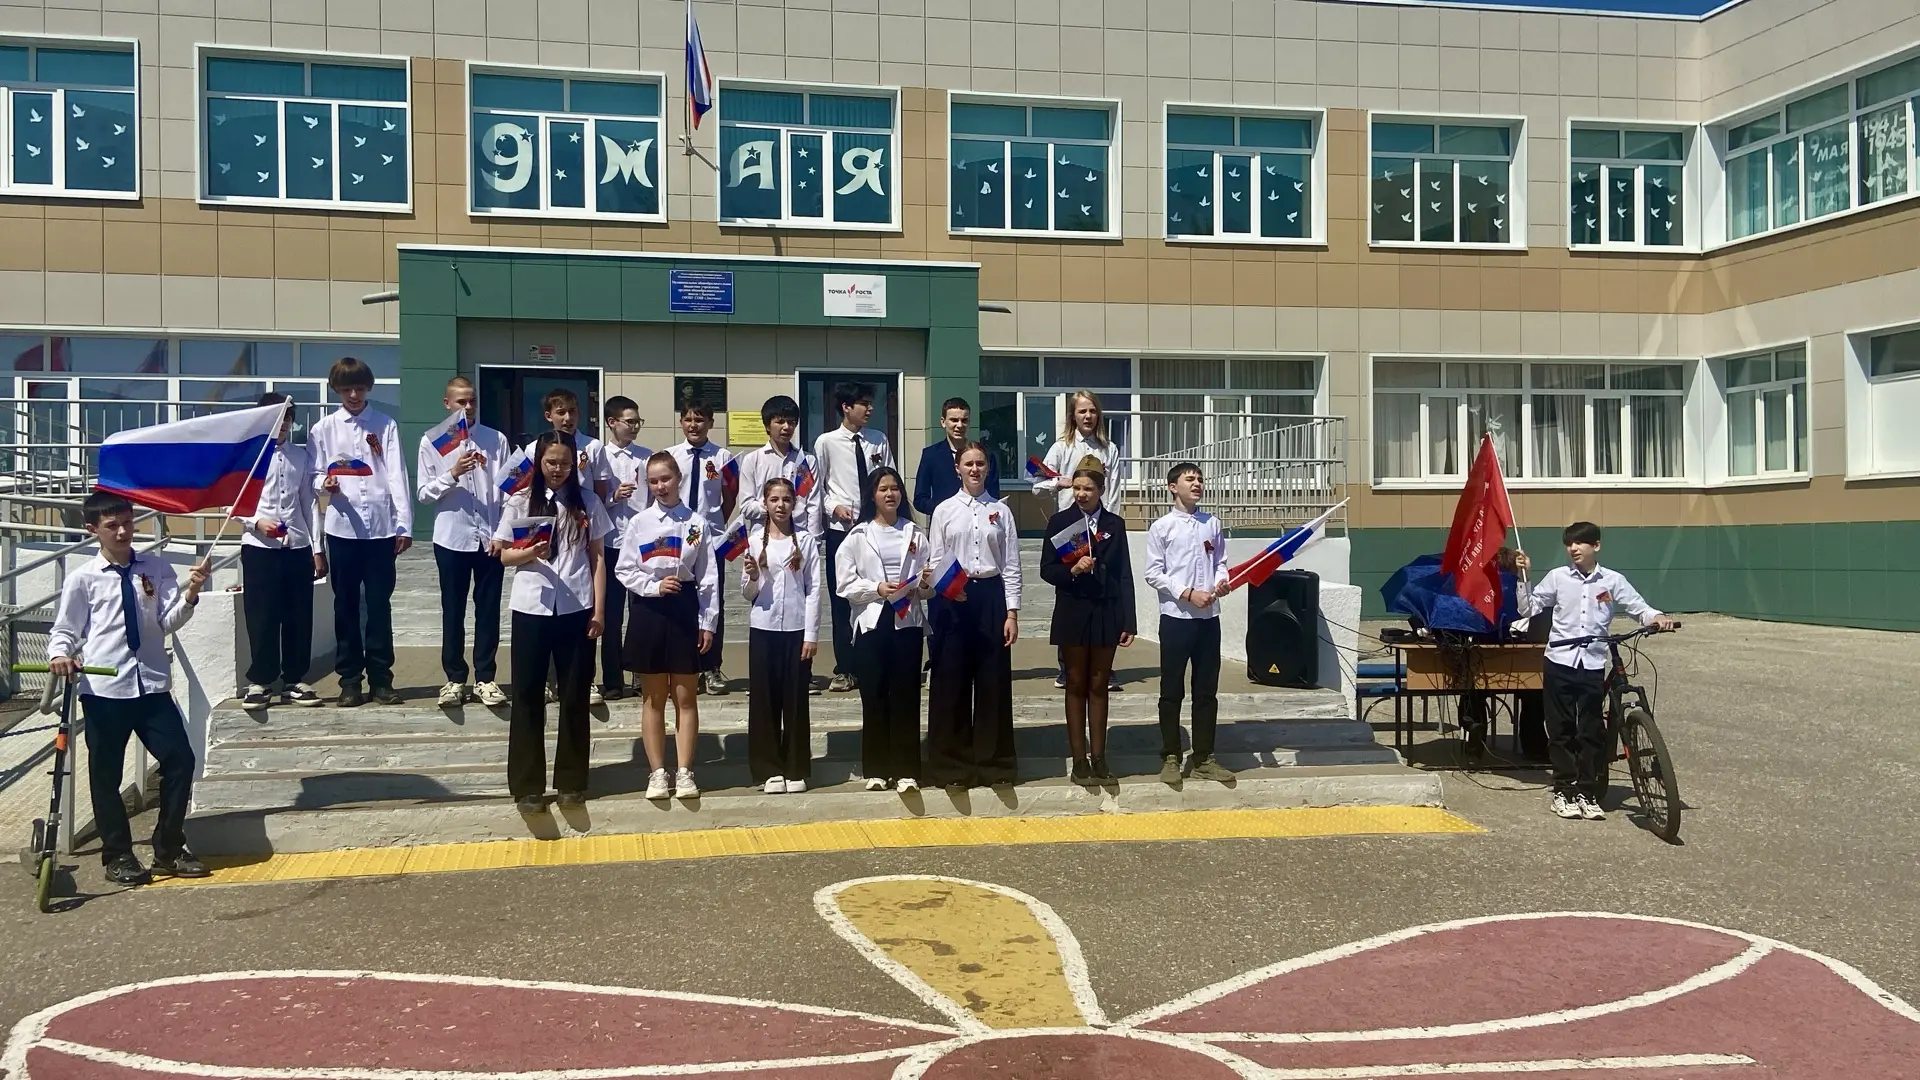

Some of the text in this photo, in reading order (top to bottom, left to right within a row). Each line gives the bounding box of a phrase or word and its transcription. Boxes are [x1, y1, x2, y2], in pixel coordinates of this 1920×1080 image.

[479, 122, 535, 193] 9
[1809, 135, 1849, 163] 9 МАЯ
